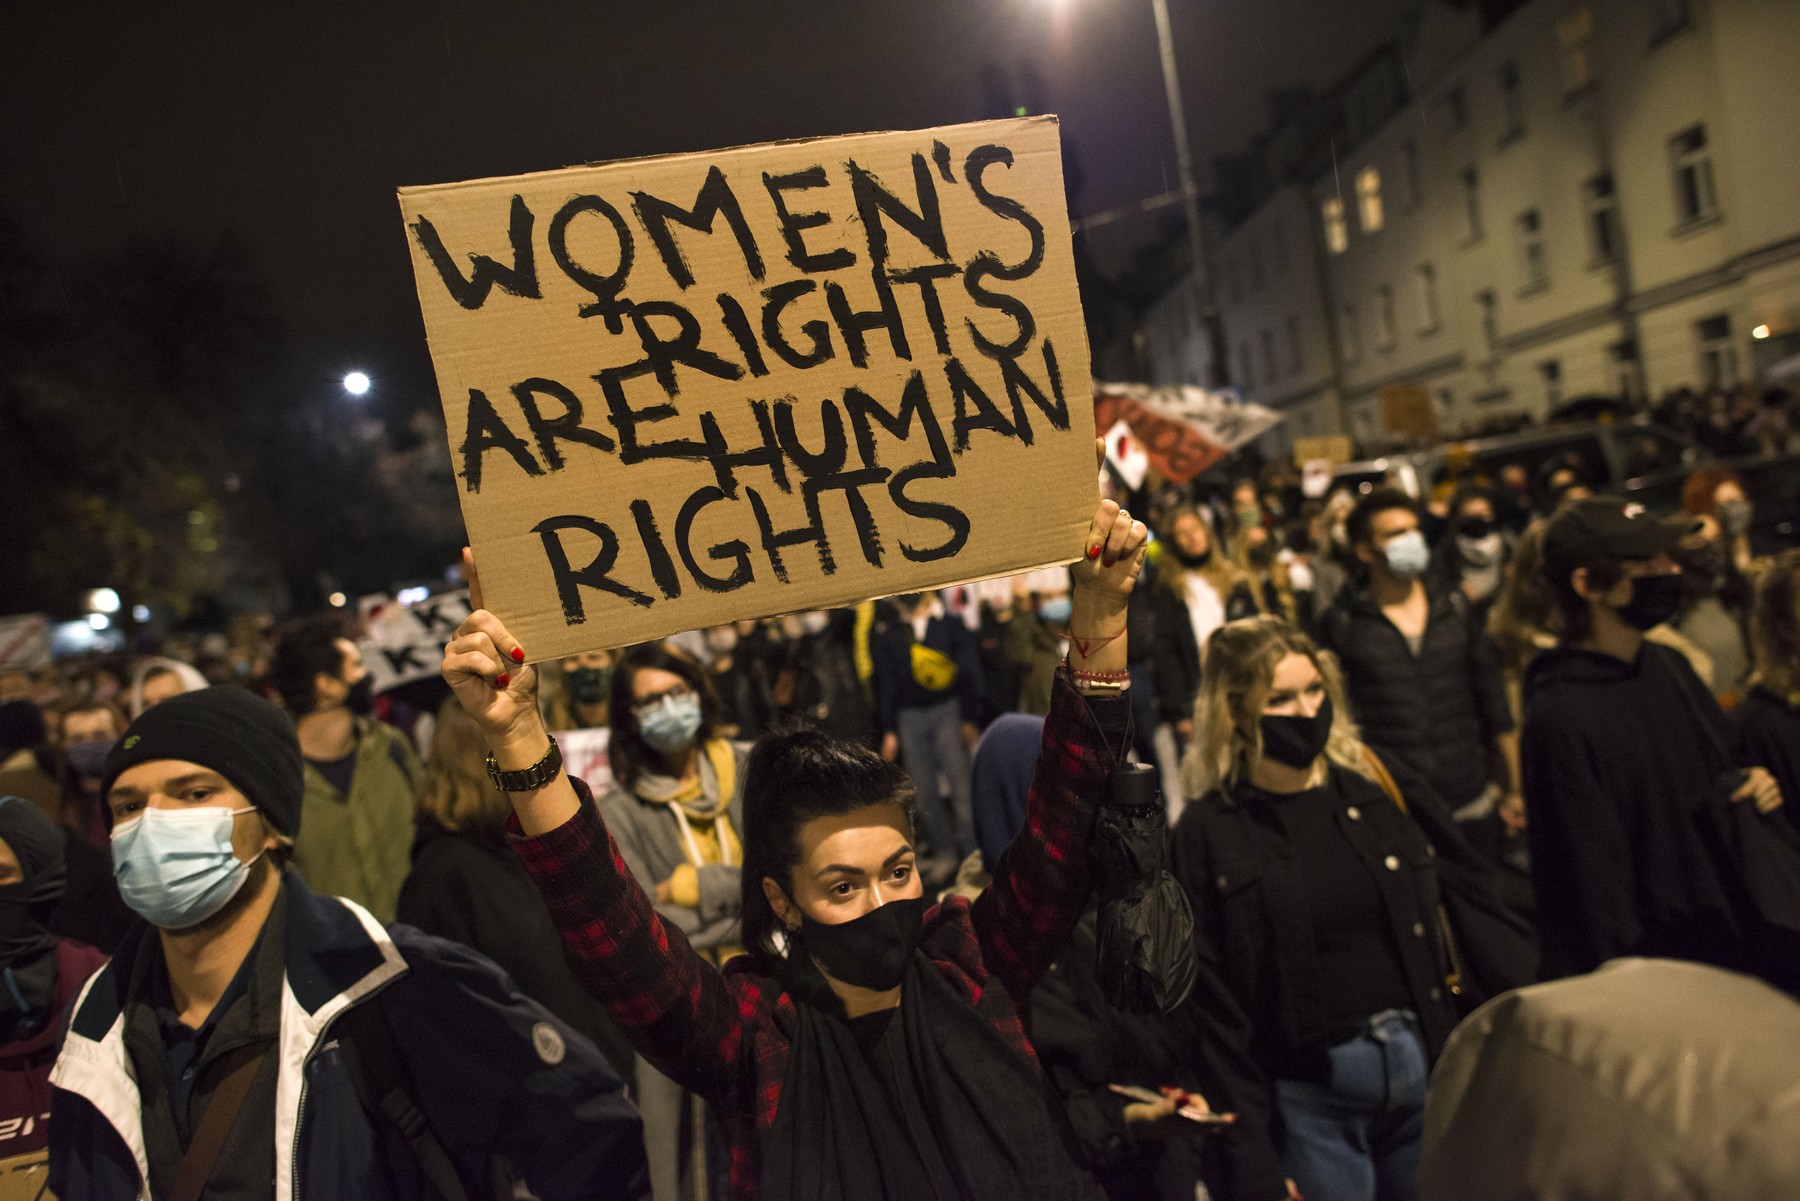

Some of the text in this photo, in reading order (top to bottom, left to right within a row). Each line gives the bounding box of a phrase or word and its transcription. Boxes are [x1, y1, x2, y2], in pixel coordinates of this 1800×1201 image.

[409, 139, 1045, 334] WOMEN'S
[627, 250, 1036, 396] RIGHTS
[457, 359, 712, 493] ARE
[700, 336, 1071, 499] HUMAN
[530, 461, 971, 626] RIGHTS
